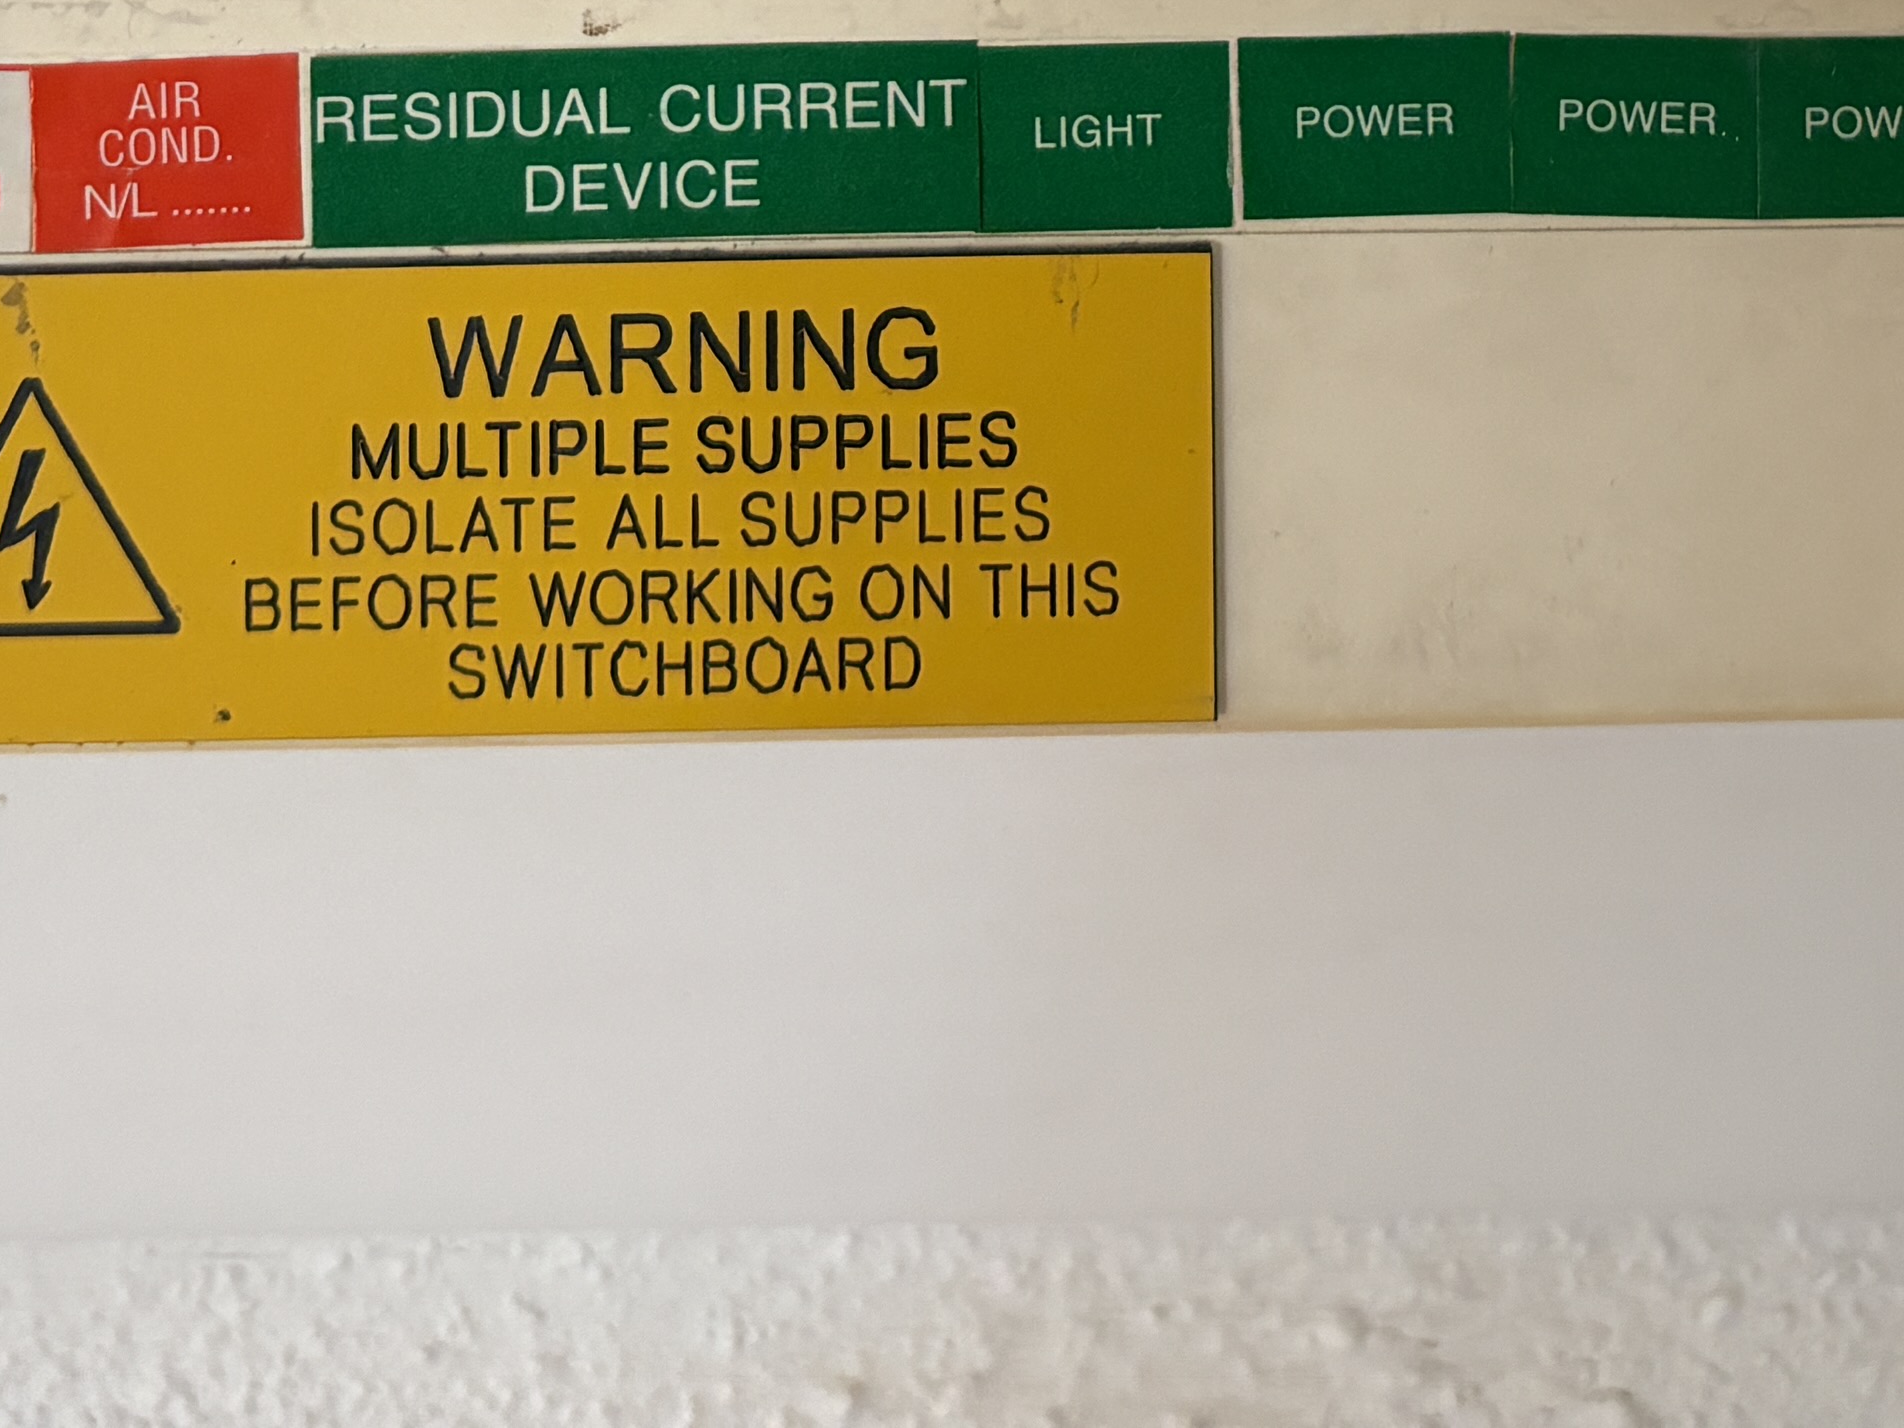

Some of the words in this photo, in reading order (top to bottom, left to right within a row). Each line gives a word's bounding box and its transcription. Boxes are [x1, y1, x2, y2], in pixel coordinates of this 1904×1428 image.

[128, 81, 201, 120] AIR
[316, 83, 630, 144] RESIDUAL
[659, 79, 967, 137] CURRENT
[1293, 101, 1454, 140] POWER
[1556, 97, 1716, 136] POWER
[99, 126, 233, 167] COND.
[1034, 112, 1162, 153] LIGHT
[84, 181, 158, 220] N/L
[524, 159, 761, 215] DEVICE
[426, 305, 941, 400] WARNING
[349, 417, 670, 482] MULTIPLE
[693, 410, 1019, 474] SUPPLIES
[308, 495, 577, 558] ISOLATE
[606, 492, 720, 553] ALL
[738, 485, 1051, 548] SUPPLIES
[244, 571, 500, 633] BEFORE
[529, 565, 840, 628] WORKING
[857, 563, 953, 620] ON
[979, 558, 1121, 620] THIS
[447, 633, 922, 702] SWITCHBOARD
